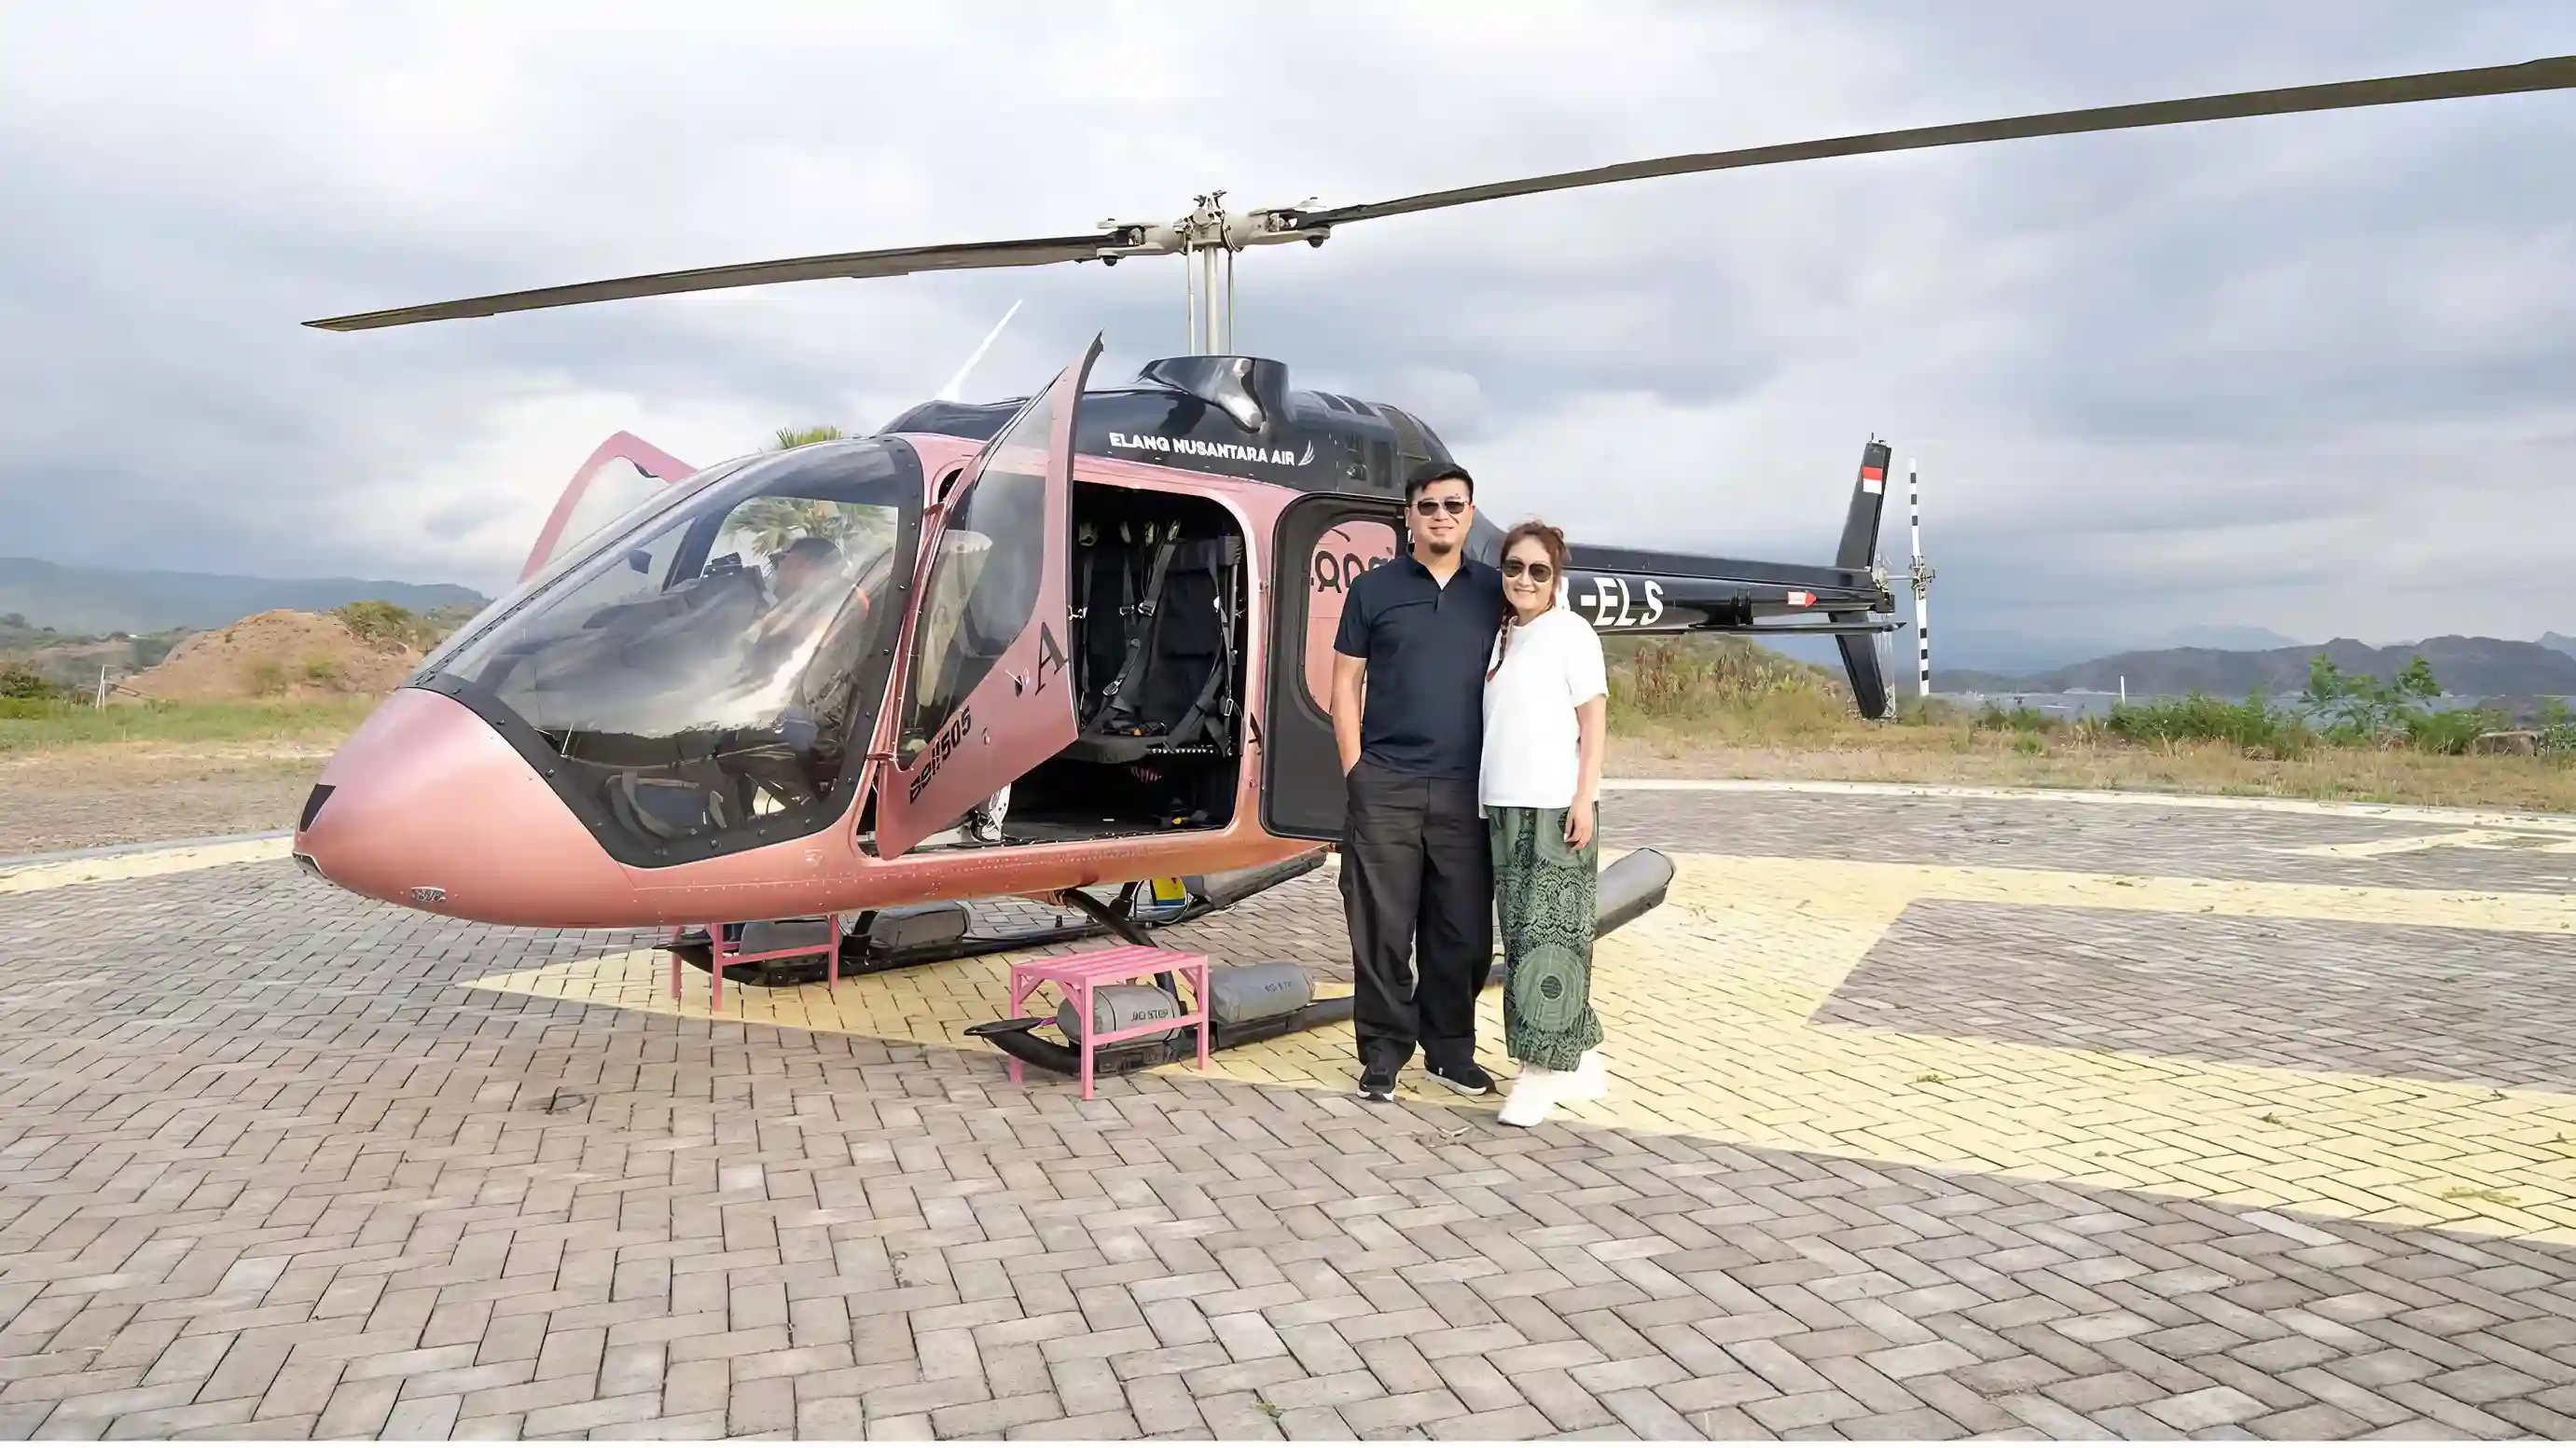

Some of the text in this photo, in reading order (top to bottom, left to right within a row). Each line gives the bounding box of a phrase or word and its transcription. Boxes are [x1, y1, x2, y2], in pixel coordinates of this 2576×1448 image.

[1109, 432, 1295, 466] ELANG NUSANTARA AIR
[1035, 621, 1069, 696] A
